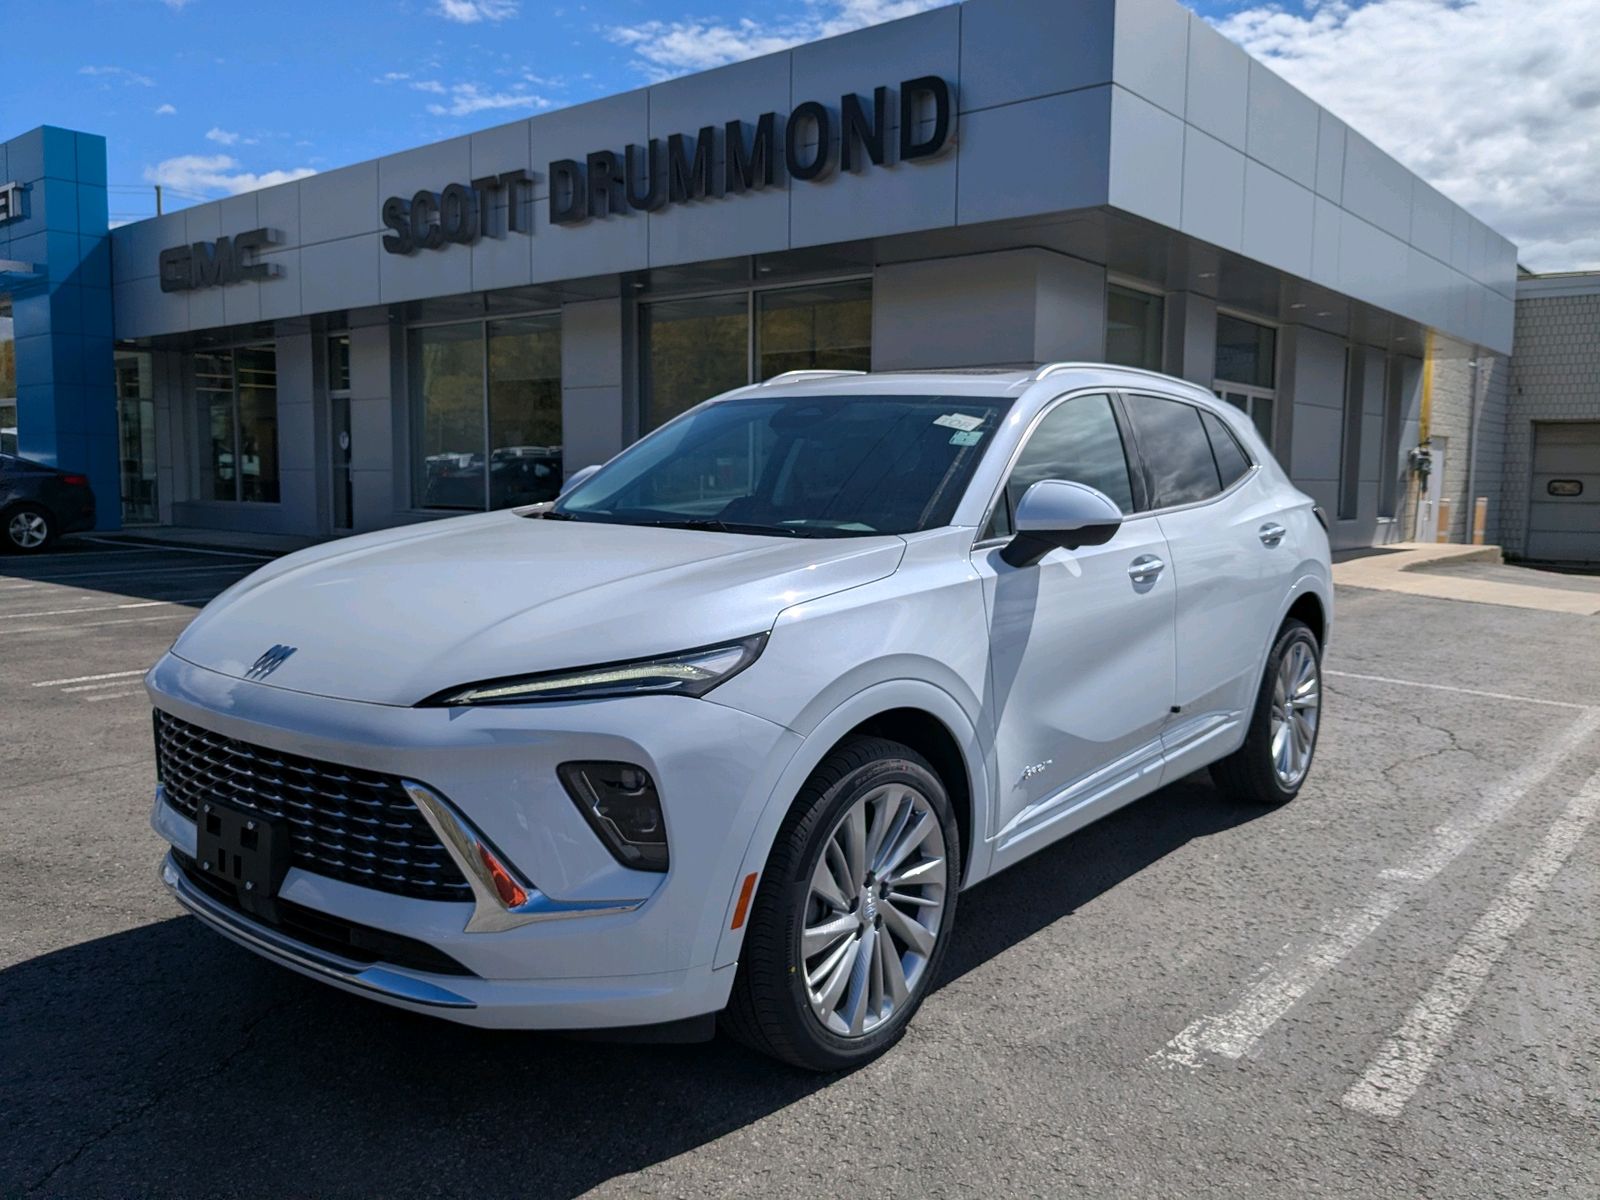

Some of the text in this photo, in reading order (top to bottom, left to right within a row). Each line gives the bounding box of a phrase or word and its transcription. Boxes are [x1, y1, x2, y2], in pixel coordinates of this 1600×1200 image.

[383, 75, 953, 257] SCOTT DRUMMOND
[160, 228, 280, 293] GMC
